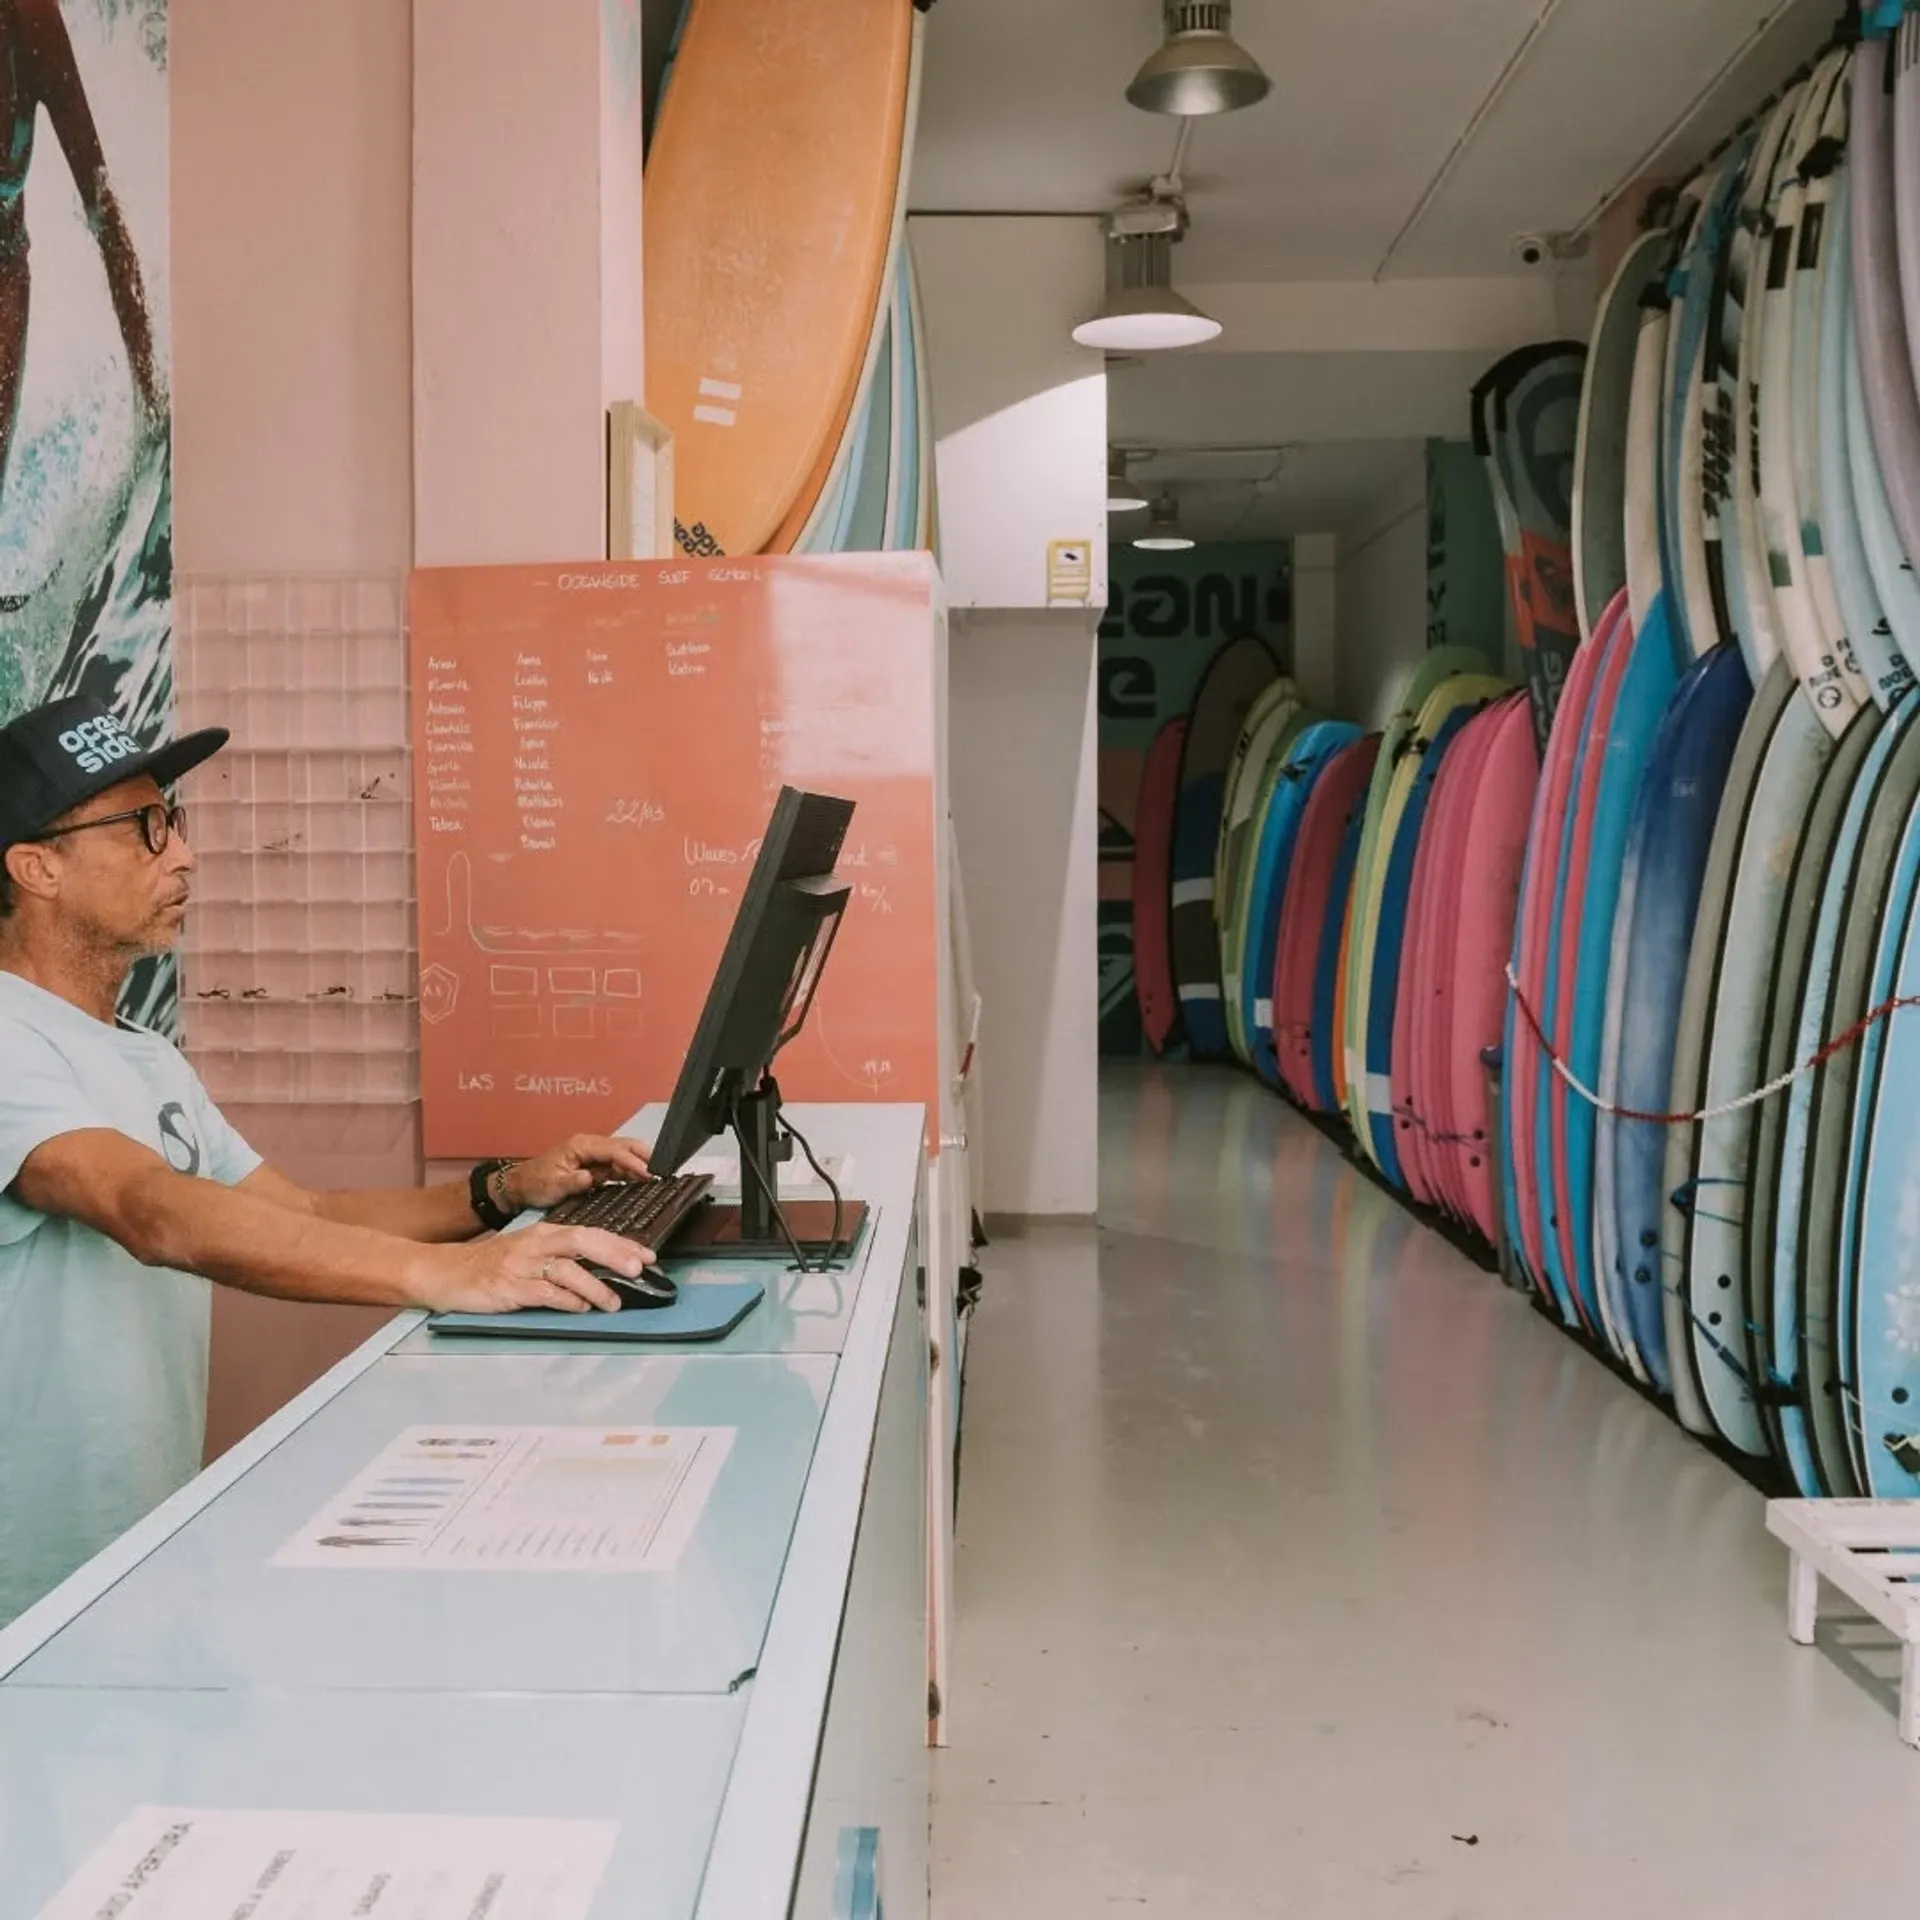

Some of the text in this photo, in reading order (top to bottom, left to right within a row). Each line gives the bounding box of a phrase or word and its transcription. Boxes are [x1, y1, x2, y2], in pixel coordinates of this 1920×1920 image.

[657, 569, 692, 584] SURF
[457, 1071, 613, 1097] LAS CANTERAS
